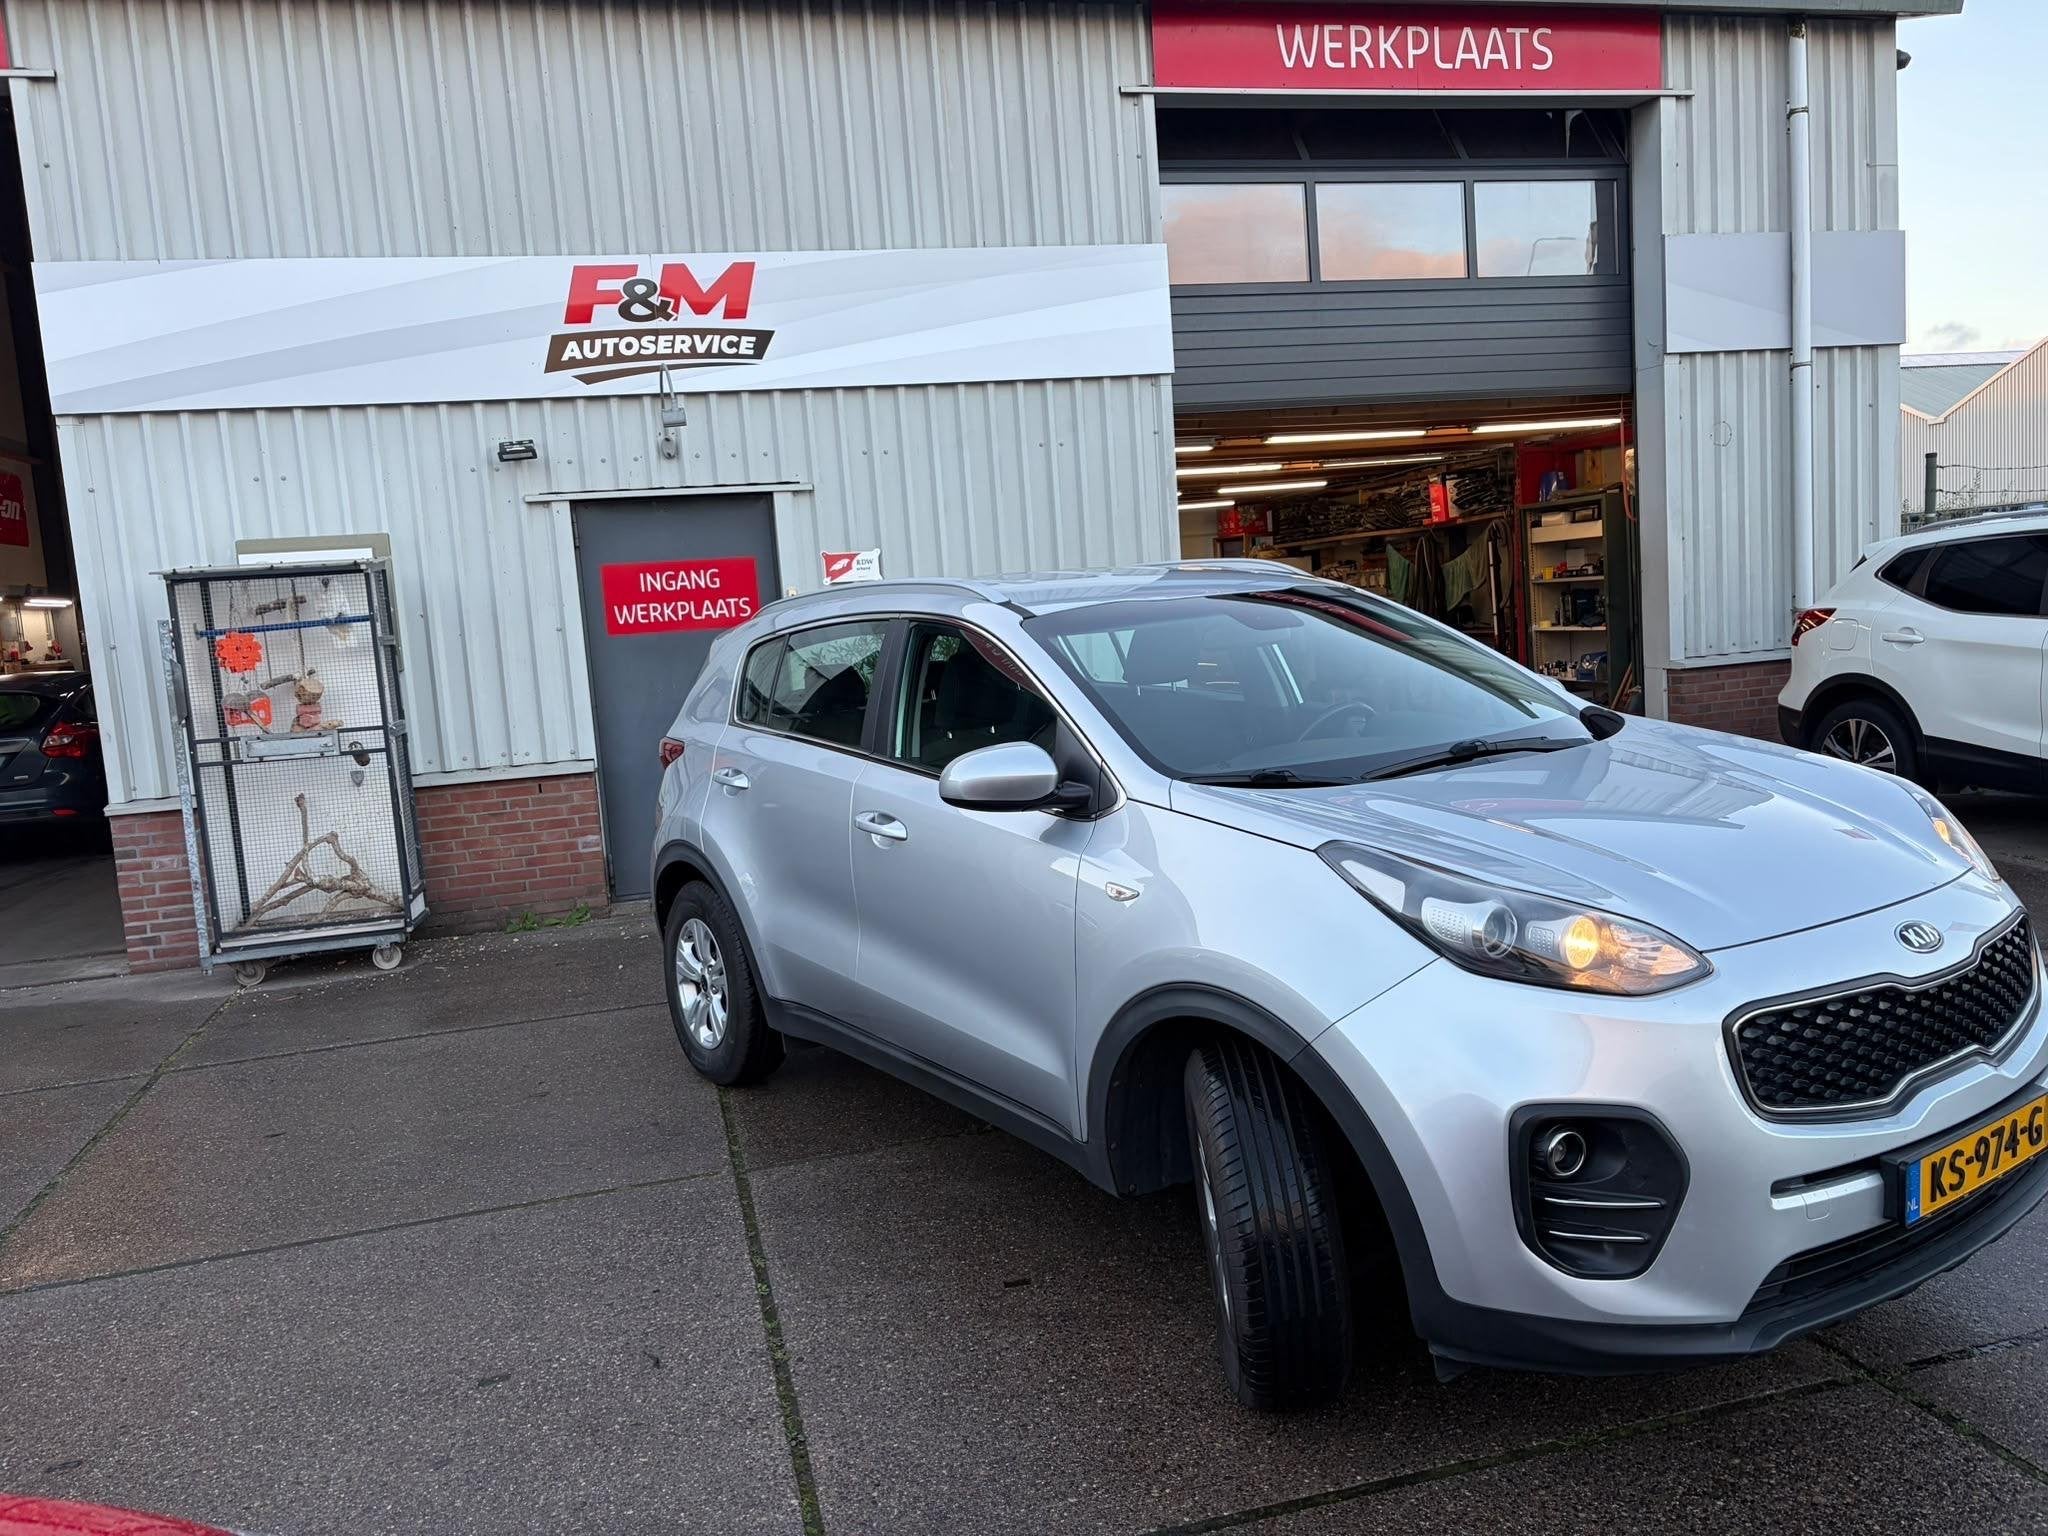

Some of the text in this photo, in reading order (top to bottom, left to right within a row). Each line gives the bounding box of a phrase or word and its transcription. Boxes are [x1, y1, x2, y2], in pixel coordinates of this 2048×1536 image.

[1276, 24, 1554, 70] WERKPLAATS
[564, 261, 756, 325] F&M
[561, 334, 757, 361] AUTOSERVICE
[639, 568, 720, 593] INGANG
[613, 597, 752, 625] WERKPLAATS
[1901, 924, 1940, 947] KIA
[1906, 1105, 2043, 1212] NL KS-974-G
